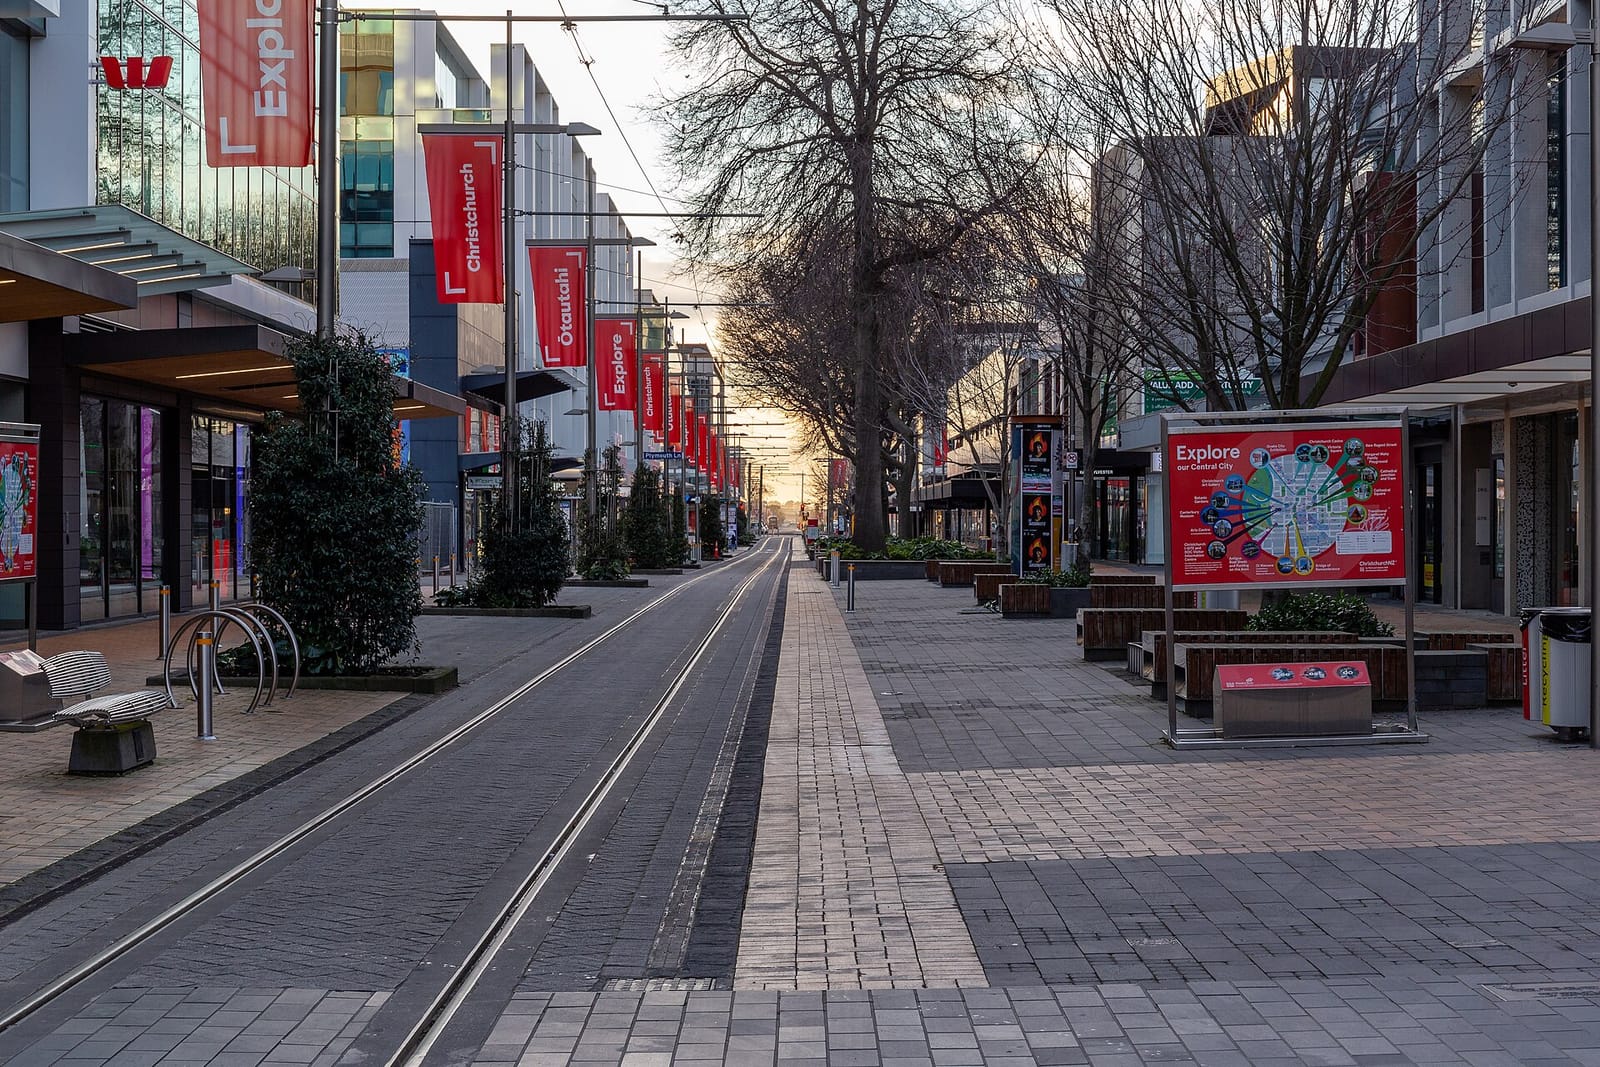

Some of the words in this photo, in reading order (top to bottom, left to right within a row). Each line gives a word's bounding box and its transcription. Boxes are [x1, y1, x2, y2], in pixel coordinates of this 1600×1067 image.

[459, 163, 481, 272] Christchurch
[553, 267, 573, 346] Ōtautahi
[611, 333, 628, 395] Explore
[1148, 381, 1173, 389] ALU
[1175, 381, 1194, 389] ADD
[643, 366, 654, 417] Christchurch
[1176, 444, 1241, 464] Explore
[1190, 462, 1218, 471] Central
[1218, 462, 1234, 471] City
